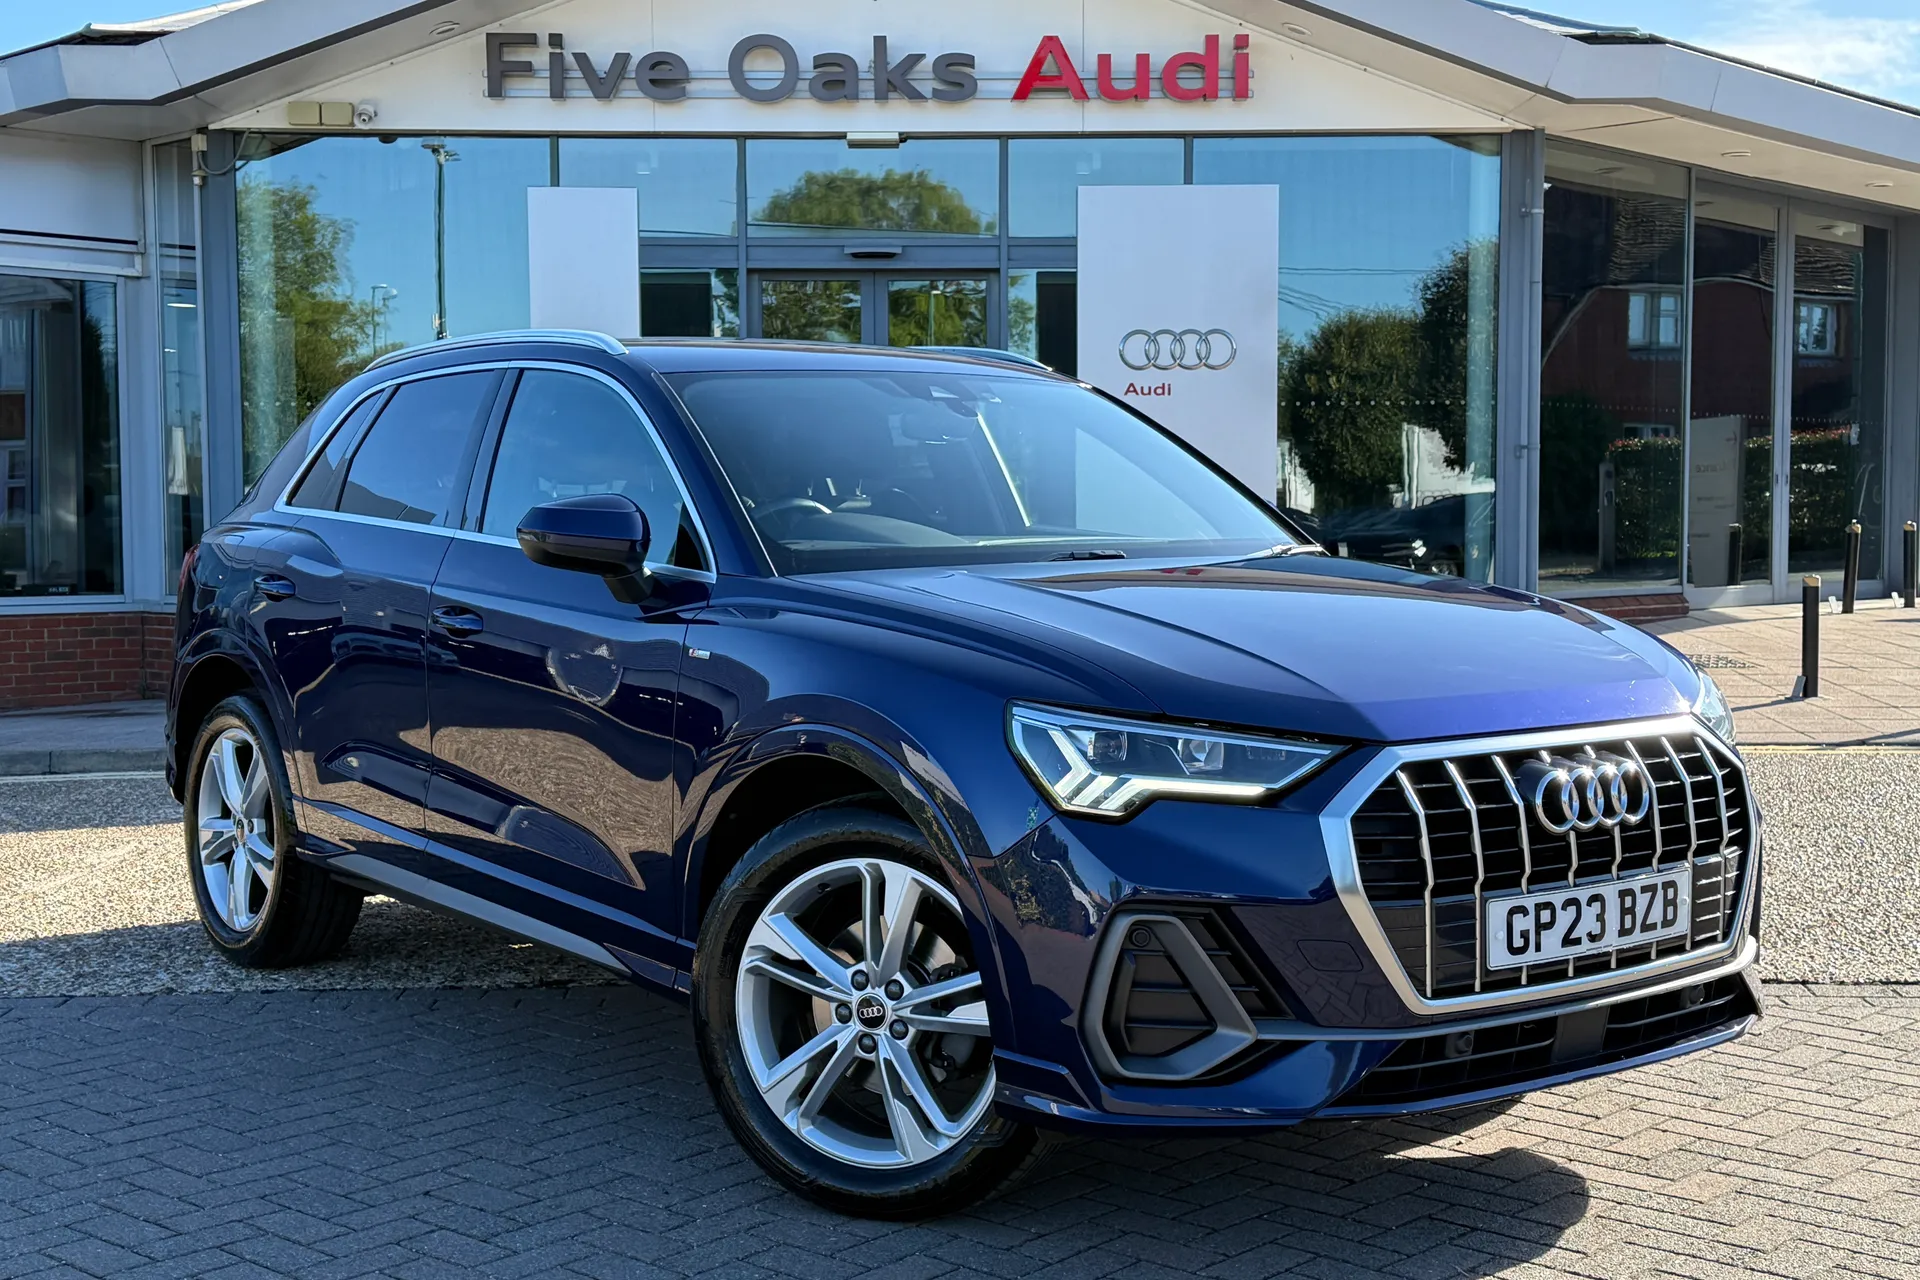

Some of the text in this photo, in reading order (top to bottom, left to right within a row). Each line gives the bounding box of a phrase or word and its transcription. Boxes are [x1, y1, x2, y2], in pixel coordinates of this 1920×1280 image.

[486, 32, 1250, 103] Five Oaks Audi
[1123, 382, 1172, 396] Audi
[1506, 879, 1679, 956] GP23 BZB
